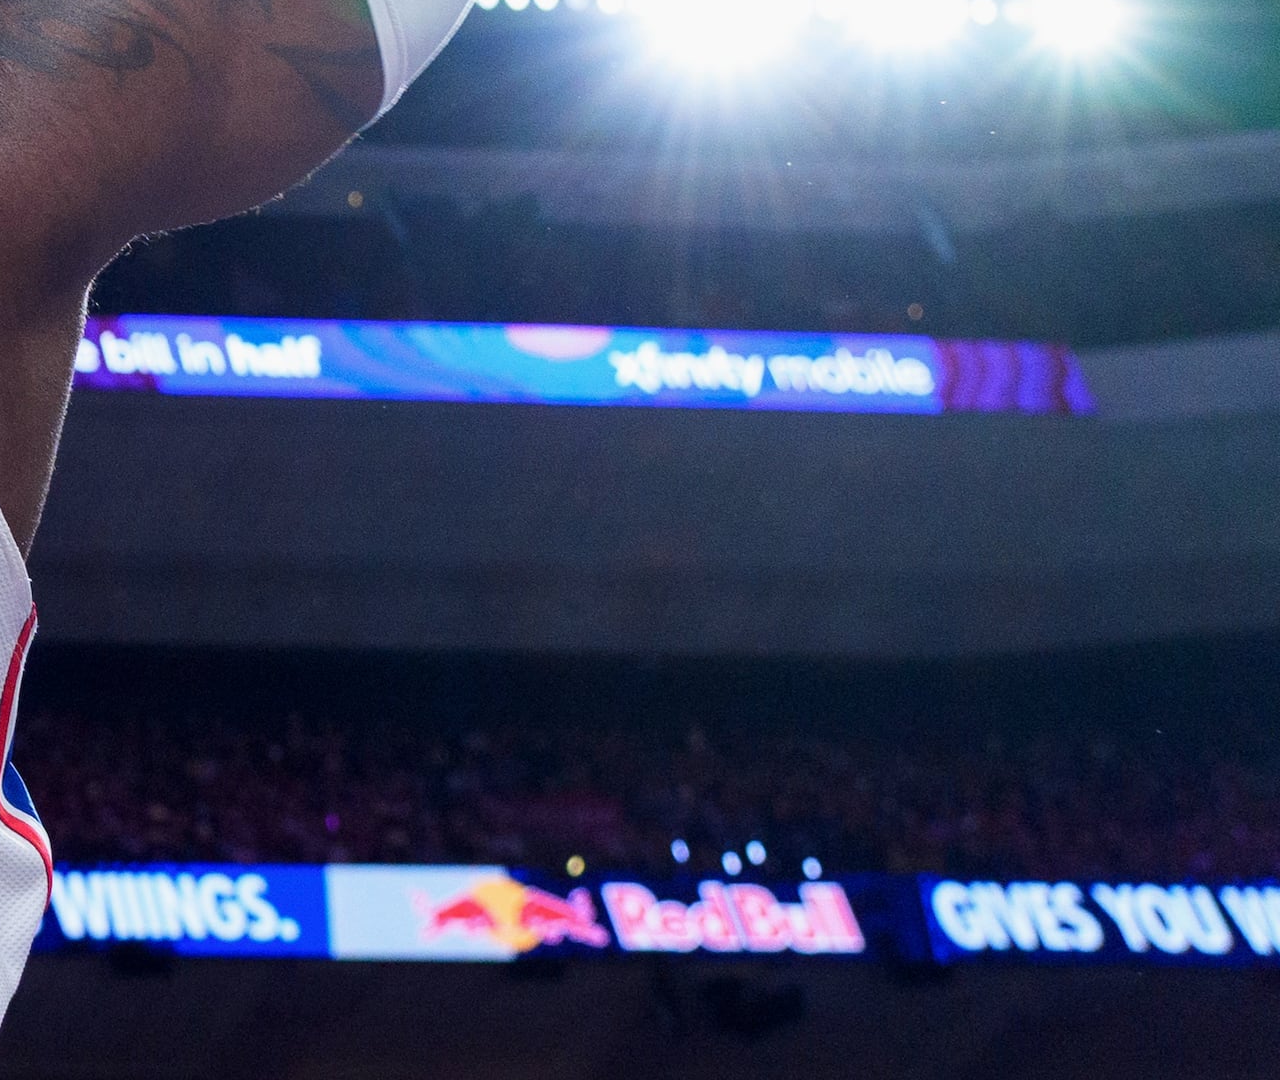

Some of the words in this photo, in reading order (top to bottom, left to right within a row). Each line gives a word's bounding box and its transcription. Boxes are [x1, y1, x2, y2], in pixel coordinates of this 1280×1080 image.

[100, 331, 178, 375] bill
[176, 333, 227, 376] in
[768, 347, 935, 396] mobile
[606, 885, 739, 949] Red
[737, 886, 861, 951] Bull
[932, 880, 1104, 952] GIVES
[1092, 882, 1235, 955] YOU
